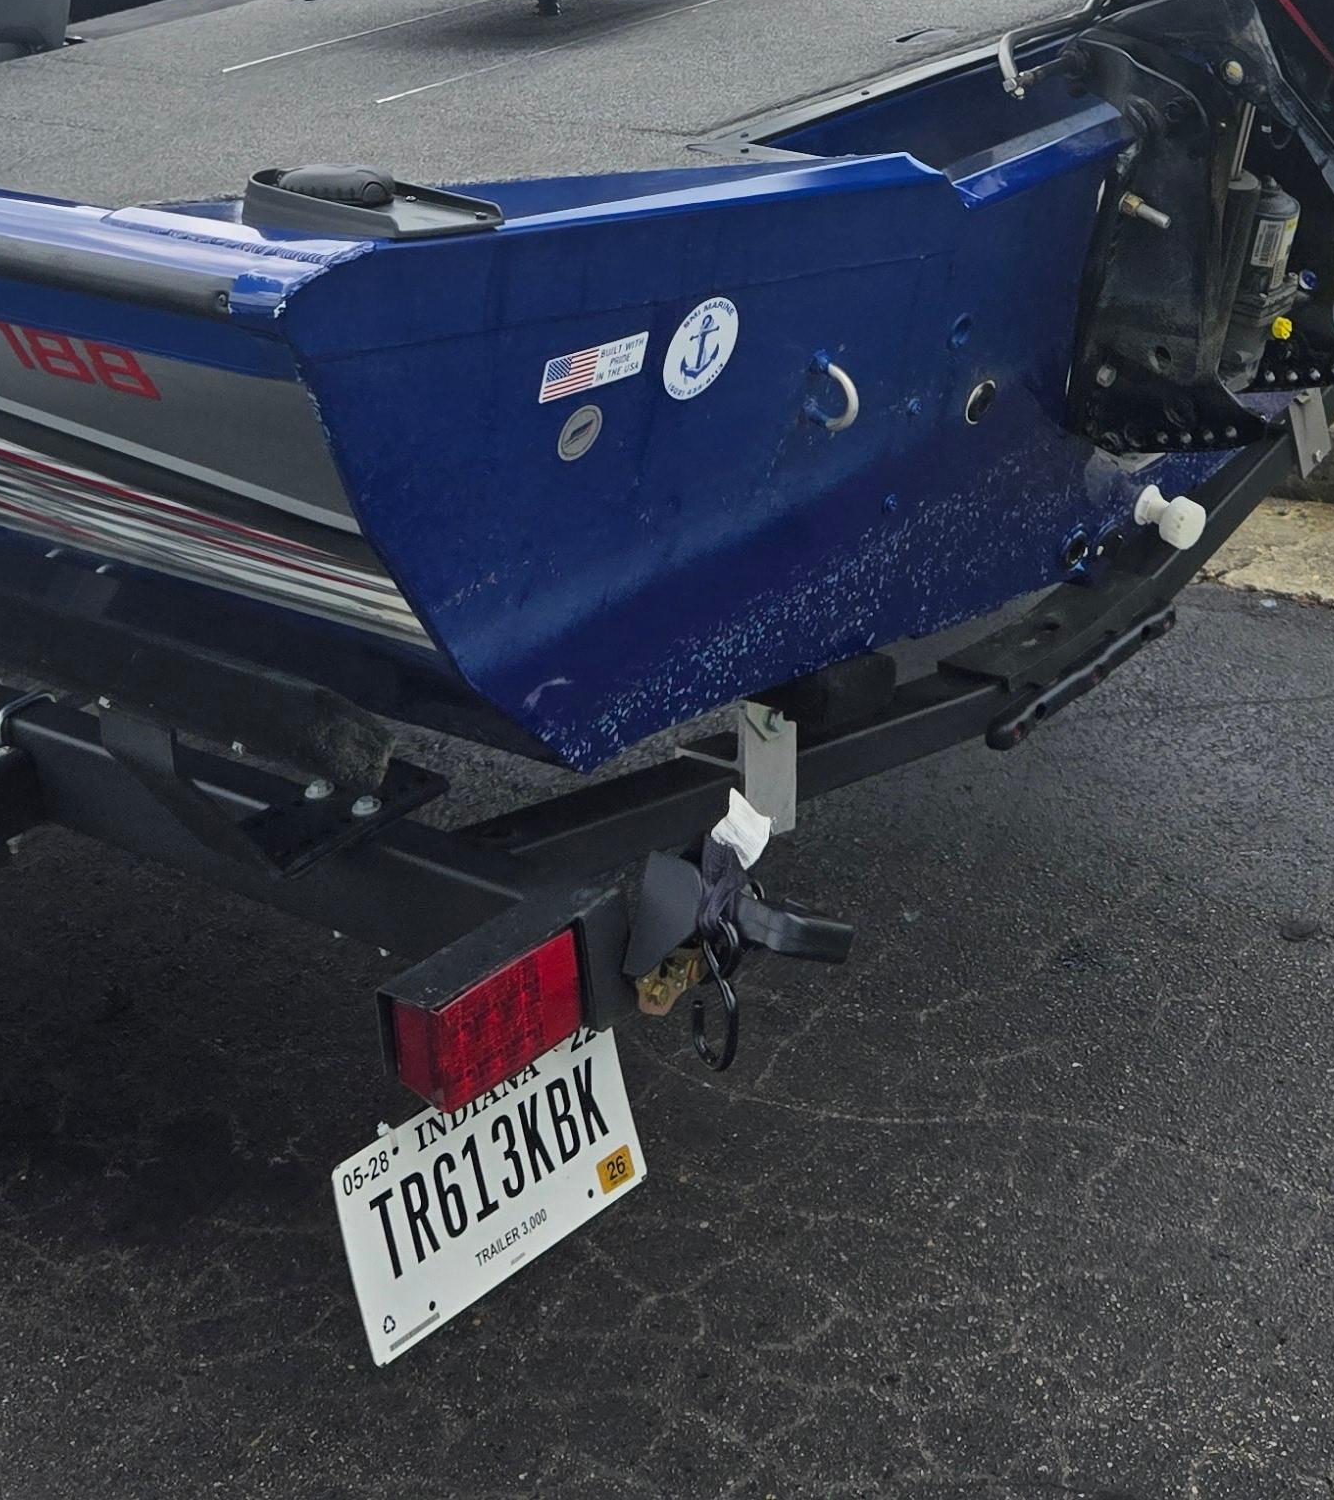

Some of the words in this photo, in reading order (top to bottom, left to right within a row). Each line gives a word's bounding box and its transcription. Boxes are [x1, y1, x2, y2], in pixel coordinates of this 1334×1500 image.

[703, 301, 735, 317] MARINE
[600, 344, 623, 358] BUILT
[625, 337, 645, 351] WITH
[609, 353, 632, 367] PRIDE
[595, 372, 604, 382] IN
[607, 366, 623, 379] THE
[624, 360, 639, 373] USA
[414, 1063, 541, 1152] INDIANA
[343, 1151, 389, 1196] 05-28
[369, 1056, 609, 1280] TR613KBK
[607, 1155, 626, 1181] 26
[475, 1227, 521, 1267] TRAILER
[521, 1208, 548, 1235] 3,000
